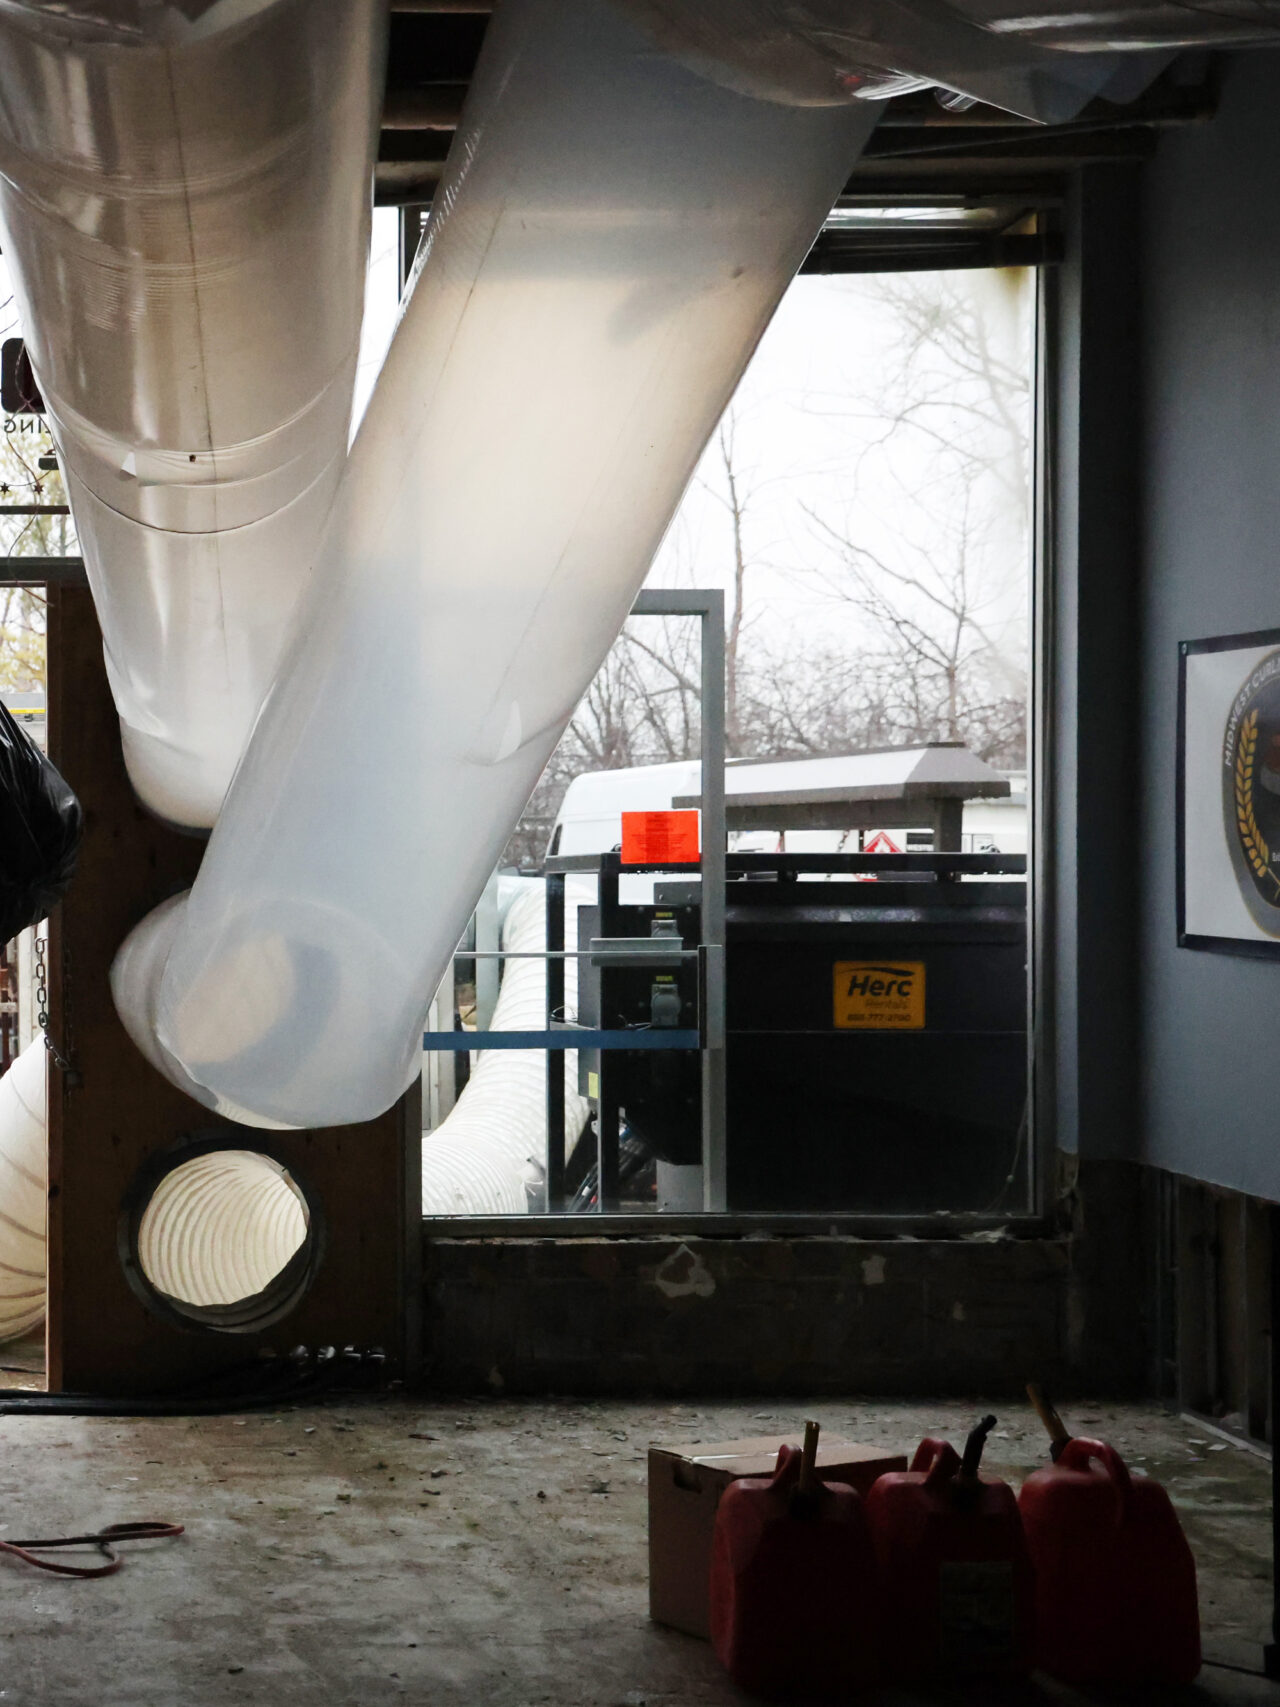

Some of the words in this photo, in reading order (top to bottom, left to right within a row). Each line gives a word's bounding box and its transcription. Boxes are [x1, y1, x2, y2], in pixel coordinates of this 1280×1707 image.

[1224, 683, 1251, 768] MIDWEST
[1251, 656, 1280, 689] CURL
[847, 975, 913, 998] Herc
